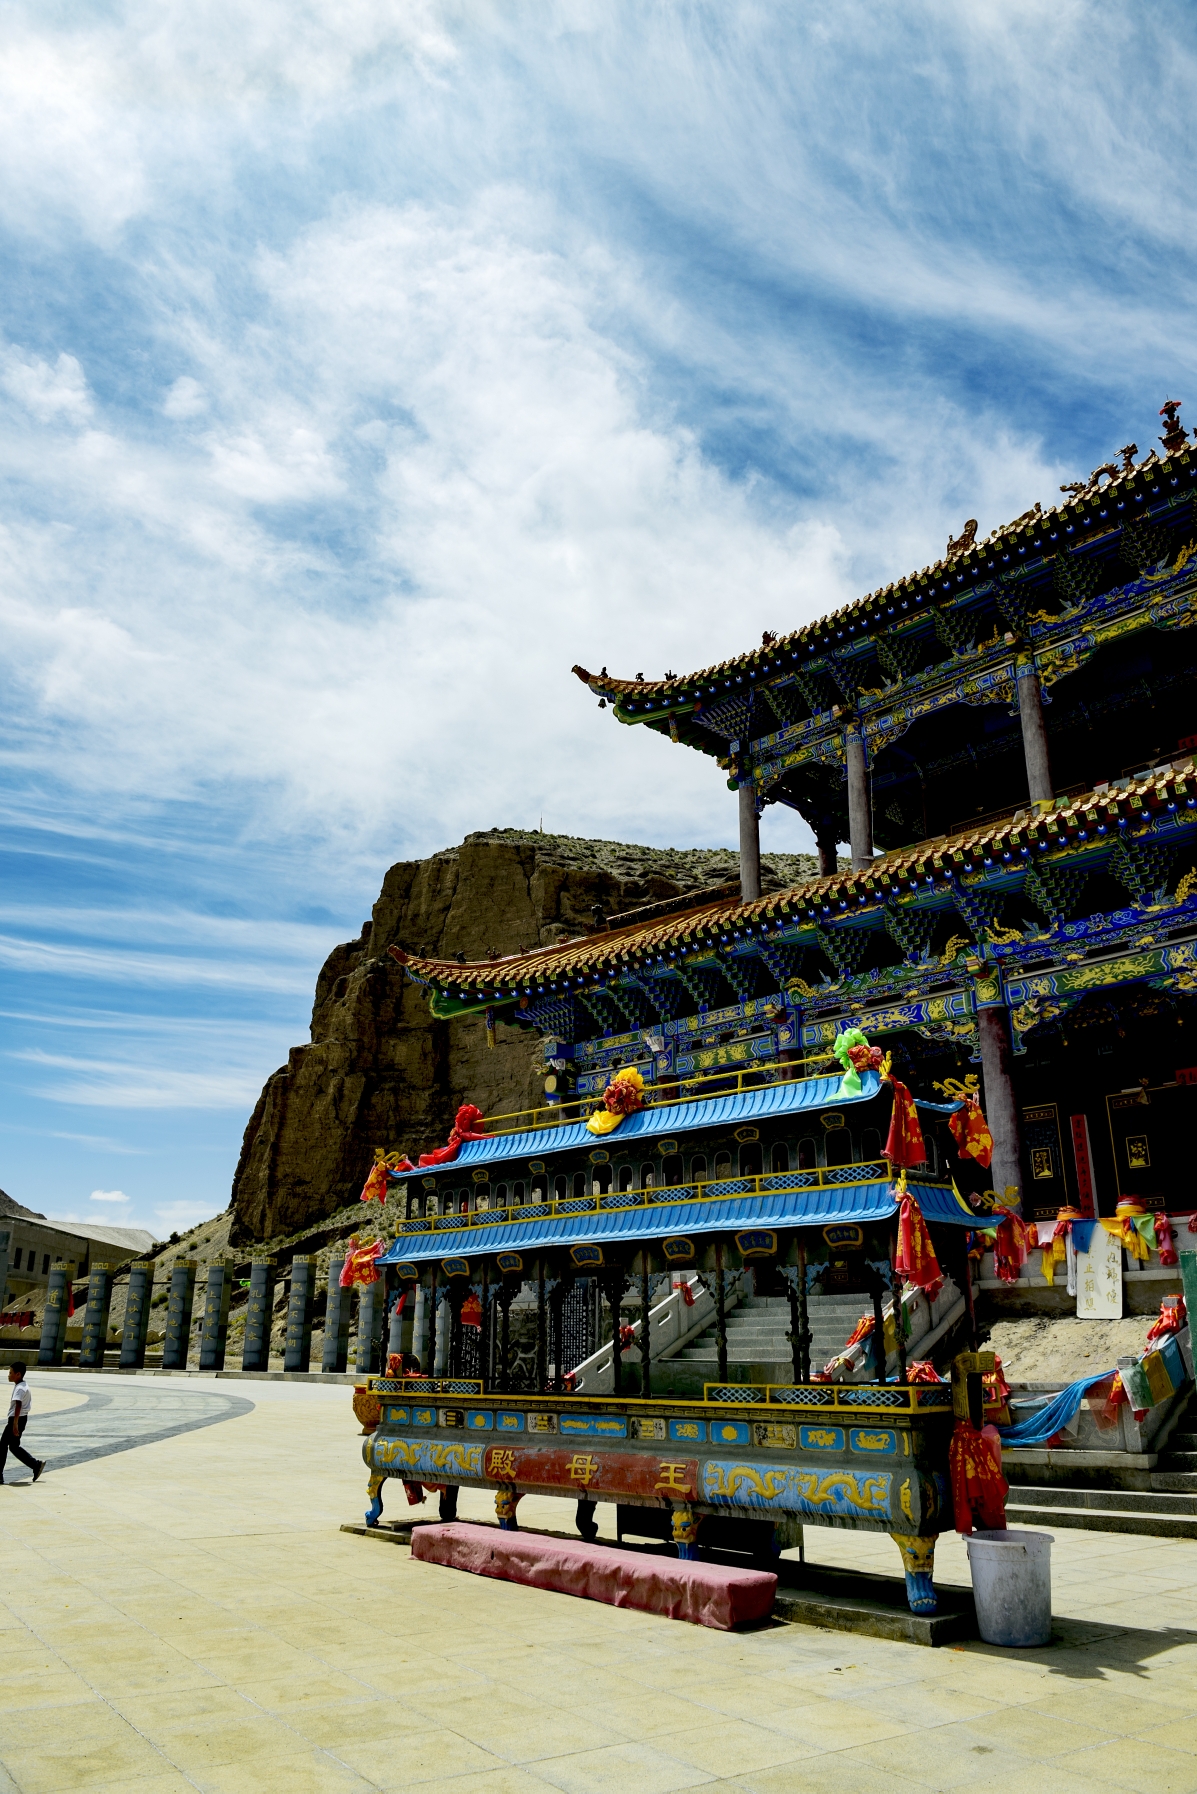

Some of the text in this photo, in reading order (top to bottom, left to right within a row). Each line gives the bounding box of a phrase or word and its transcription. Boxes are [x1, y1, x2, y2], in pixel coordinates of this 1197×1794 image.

[46, 1290, 59, 1308] 道
[125, 1291, 140, 1341] 众妙之门
[167, 1291, 181, 1341] 天长地久
[203, 1290, 217, 1341] 上善若水
[247, 1289, 262, 1341] 孔德之容
[325, 1287, 337, 1341] 道法自然
